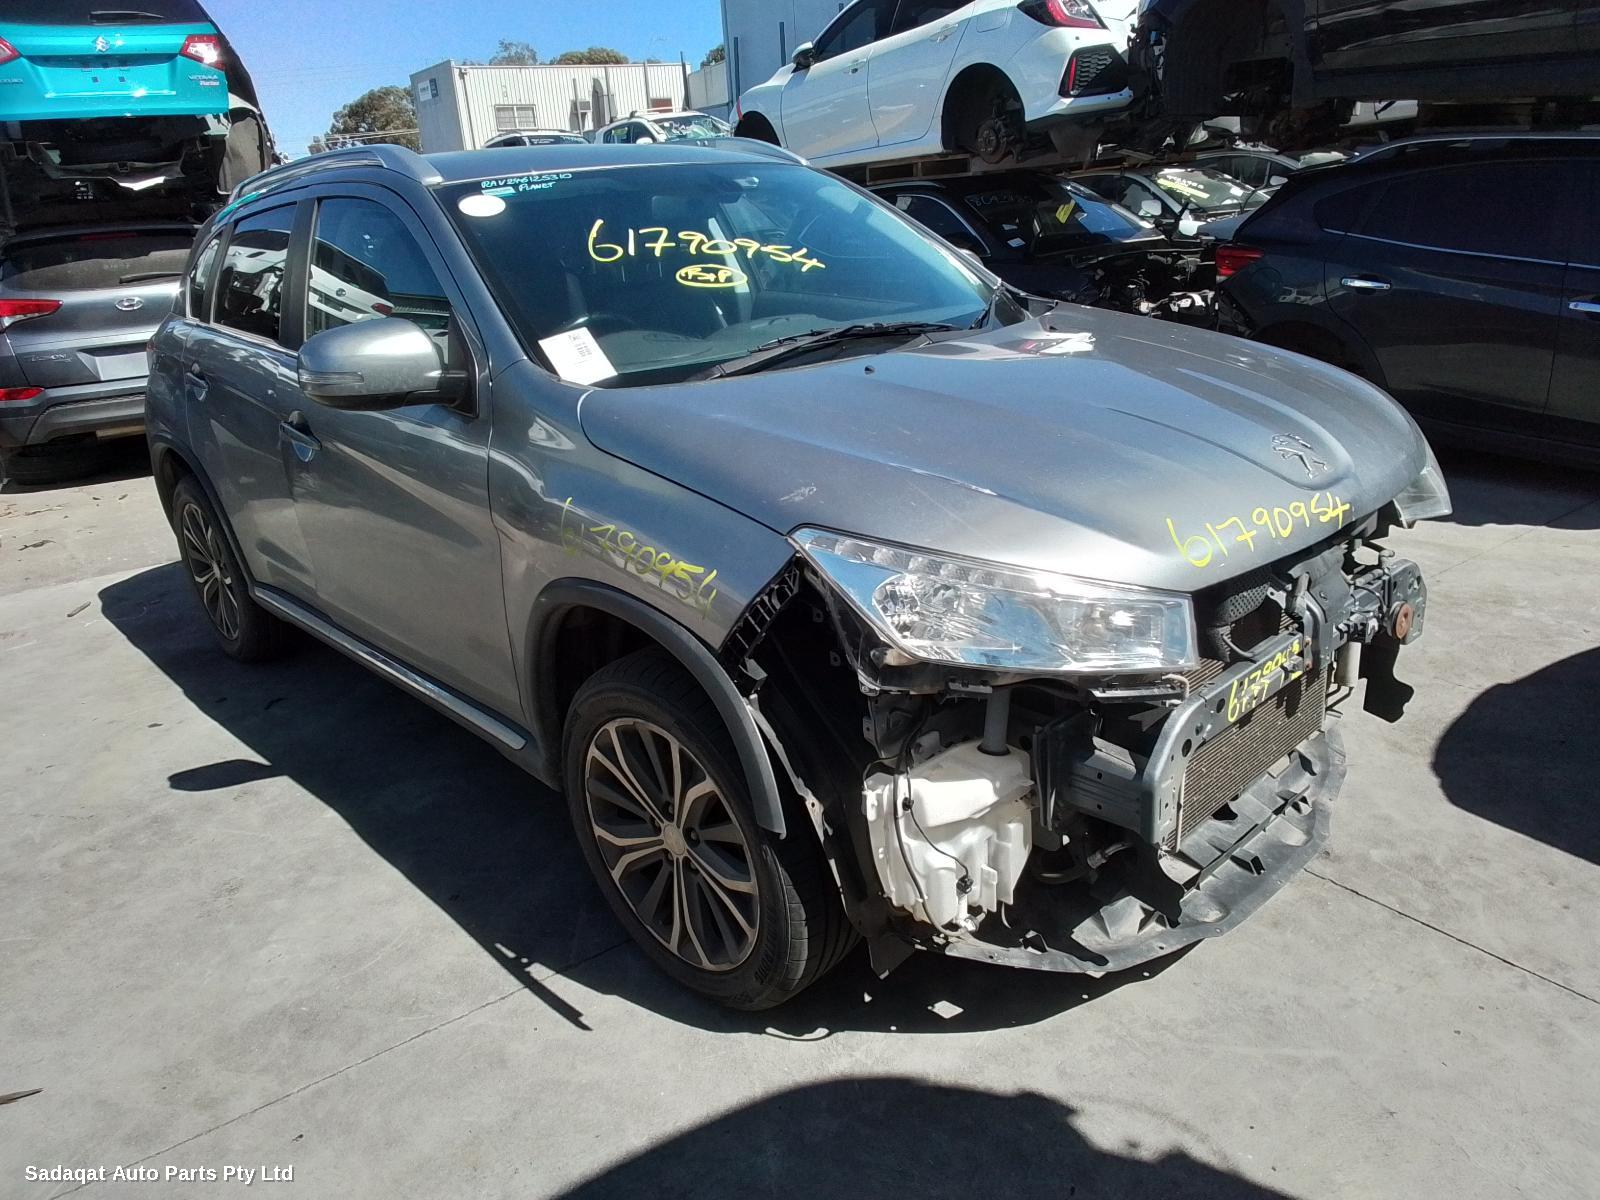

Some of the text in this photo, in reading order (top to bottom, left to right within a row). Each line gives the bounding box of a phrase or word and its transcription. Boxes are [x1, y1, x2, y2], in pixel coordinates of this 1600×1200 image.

[518, 181, 556, 192] PLANET
[588, 219, 826, 272] 61790954
[1165, 491, 1350, 568] 61790954
